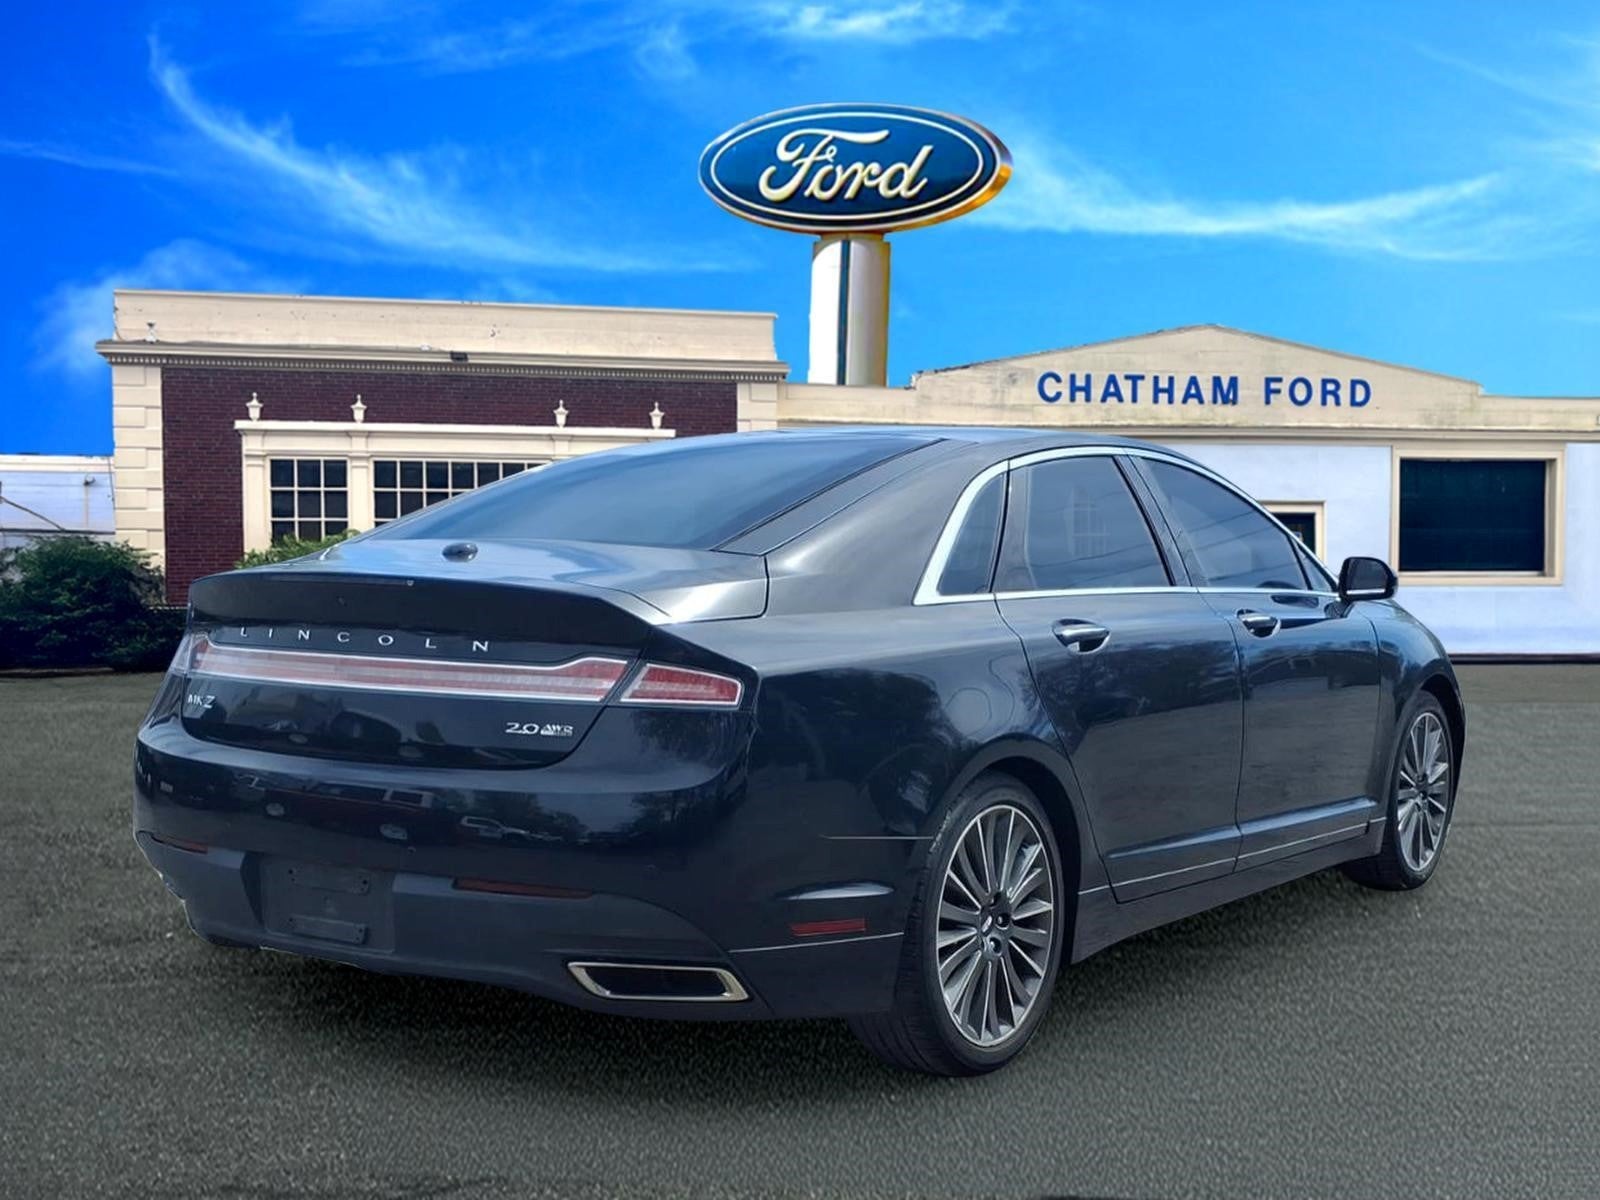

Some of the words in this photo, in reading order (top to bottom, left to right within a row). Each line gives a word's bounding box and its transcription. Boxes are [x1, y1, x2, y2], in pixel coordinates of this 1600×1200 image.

[758, 128, 933, 202] Ford
[1037, 371, 1239, 406] CHATHAM
[1264, 376, 1372, 407] FORD
[239, 627, 489, 652] LINCOLN
[187, 694, 216, 709] MKZ
